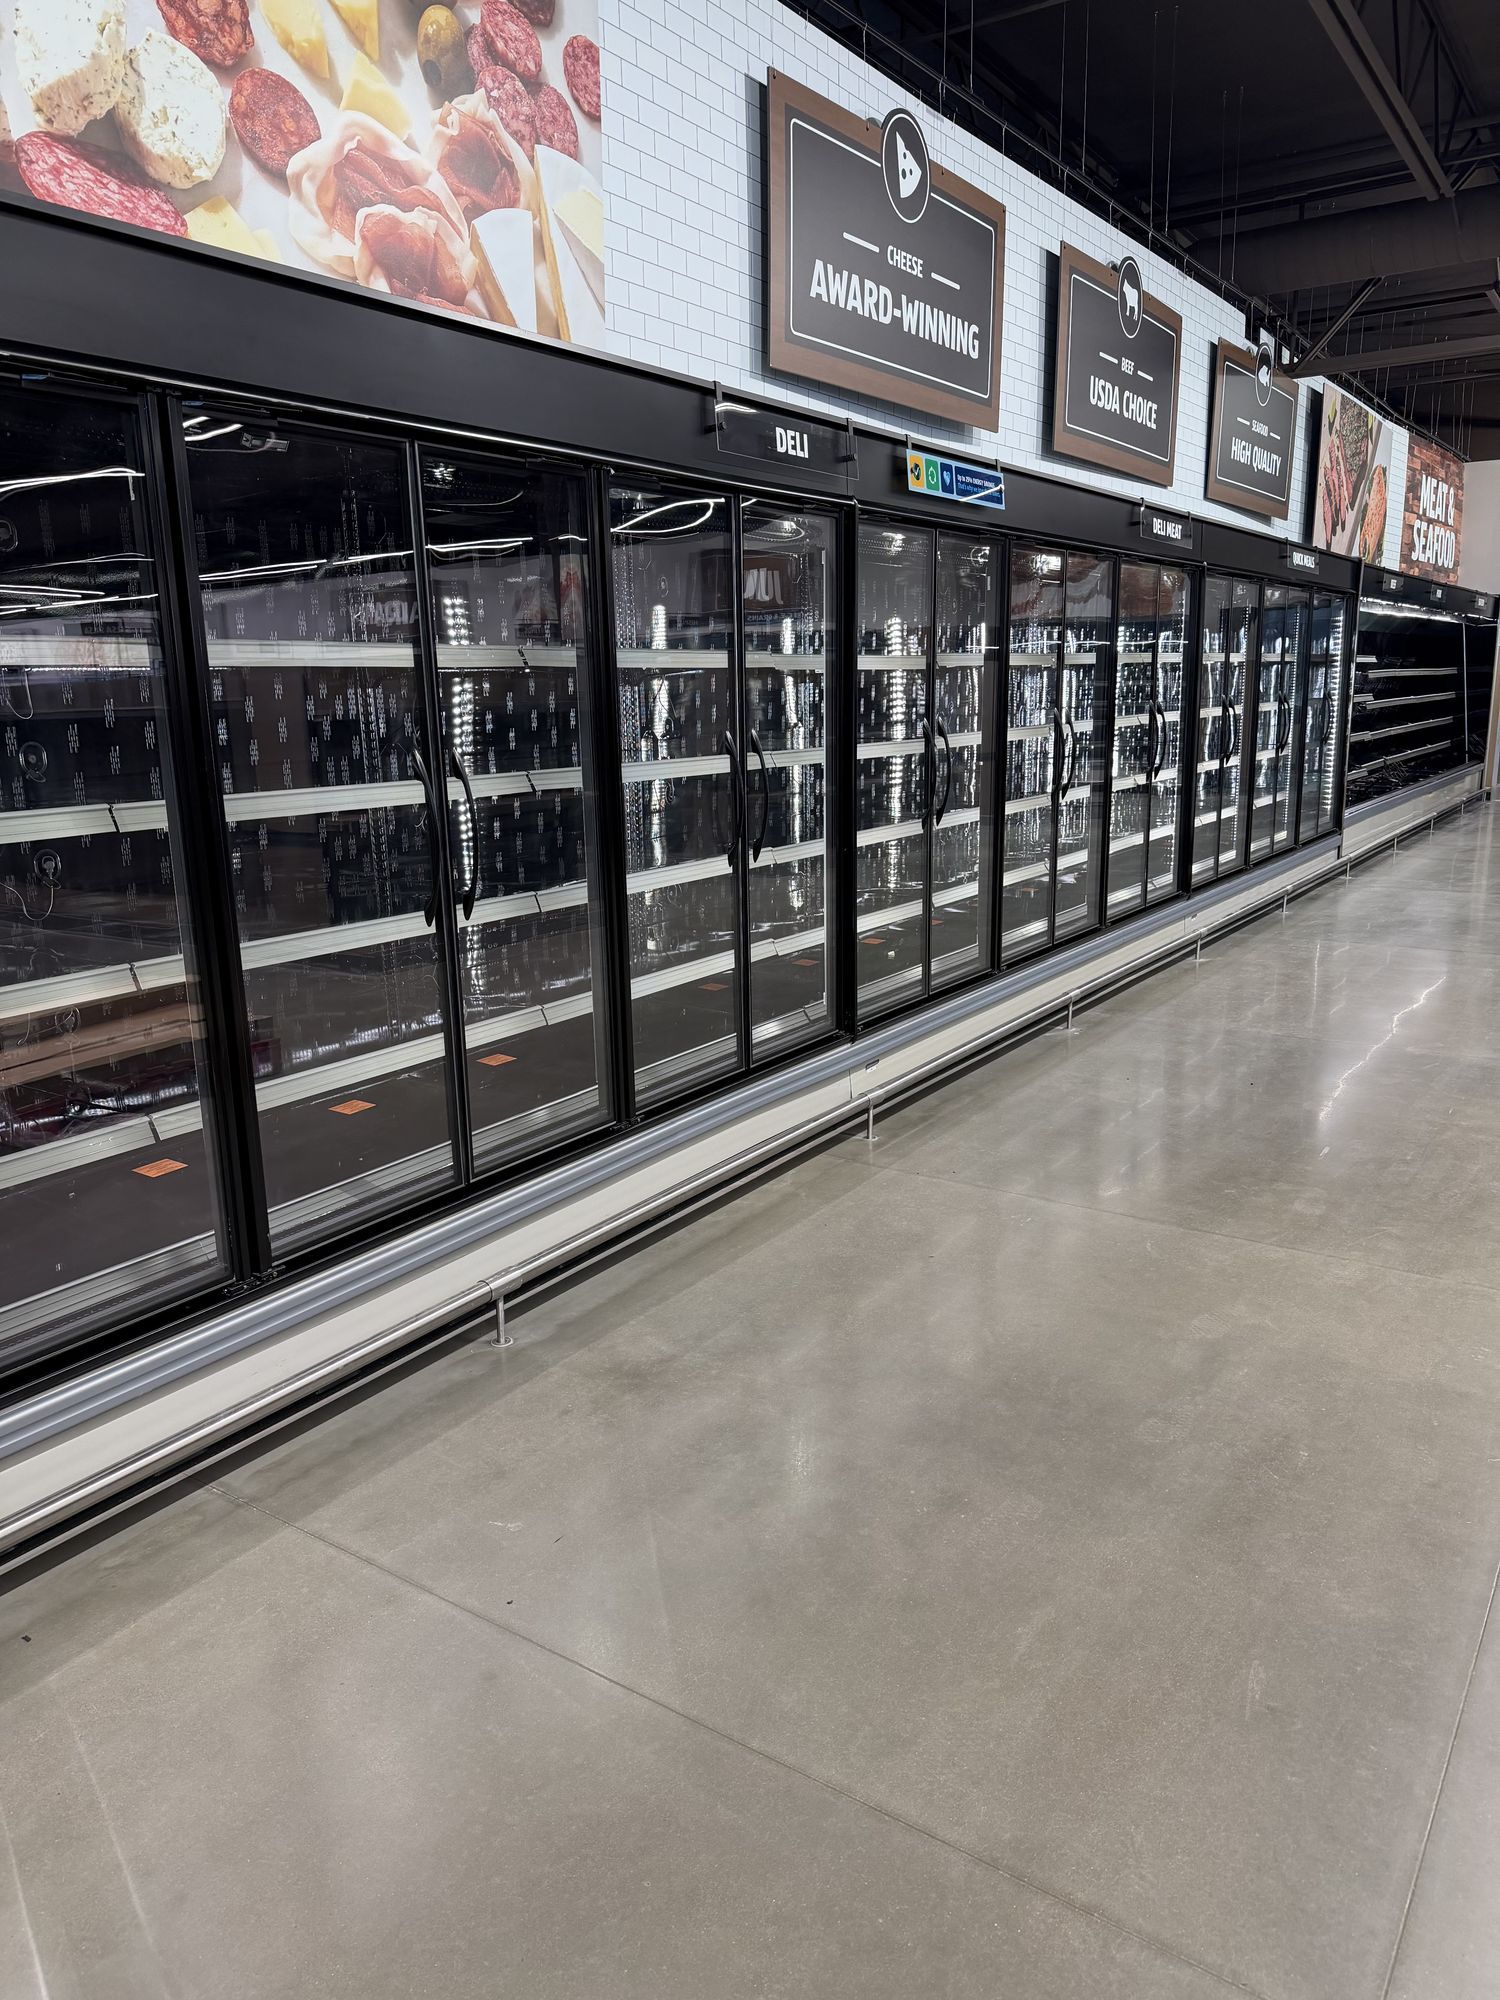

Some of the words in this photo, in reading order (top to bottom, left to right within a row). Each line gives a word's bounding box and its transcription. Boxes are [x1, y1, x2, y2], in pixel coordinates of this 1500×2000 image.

[887, 245, 923, 278] CHEESE
[809, 258, 979, 359] AWARD-WINNING
[1121, 357, 1134, 375] BEEF
[1089, 375, 1120, 414] USDA
[1122, 390, 1157, 429] CHOICE
[775, 426, 809, 459] DELI
[1231, 436, 1252, 465] HIGH
[1252, 445, 1282, 477] QUALITY
[1419, 473, 1448, 523] MEAT
[1447, 486, 1455, 527] &
[1152, 517, 1166, 536] DELI
[1166, 521, 1182, 540] MEAT
[1411, 519, 1456, 569] SEAFOOD
